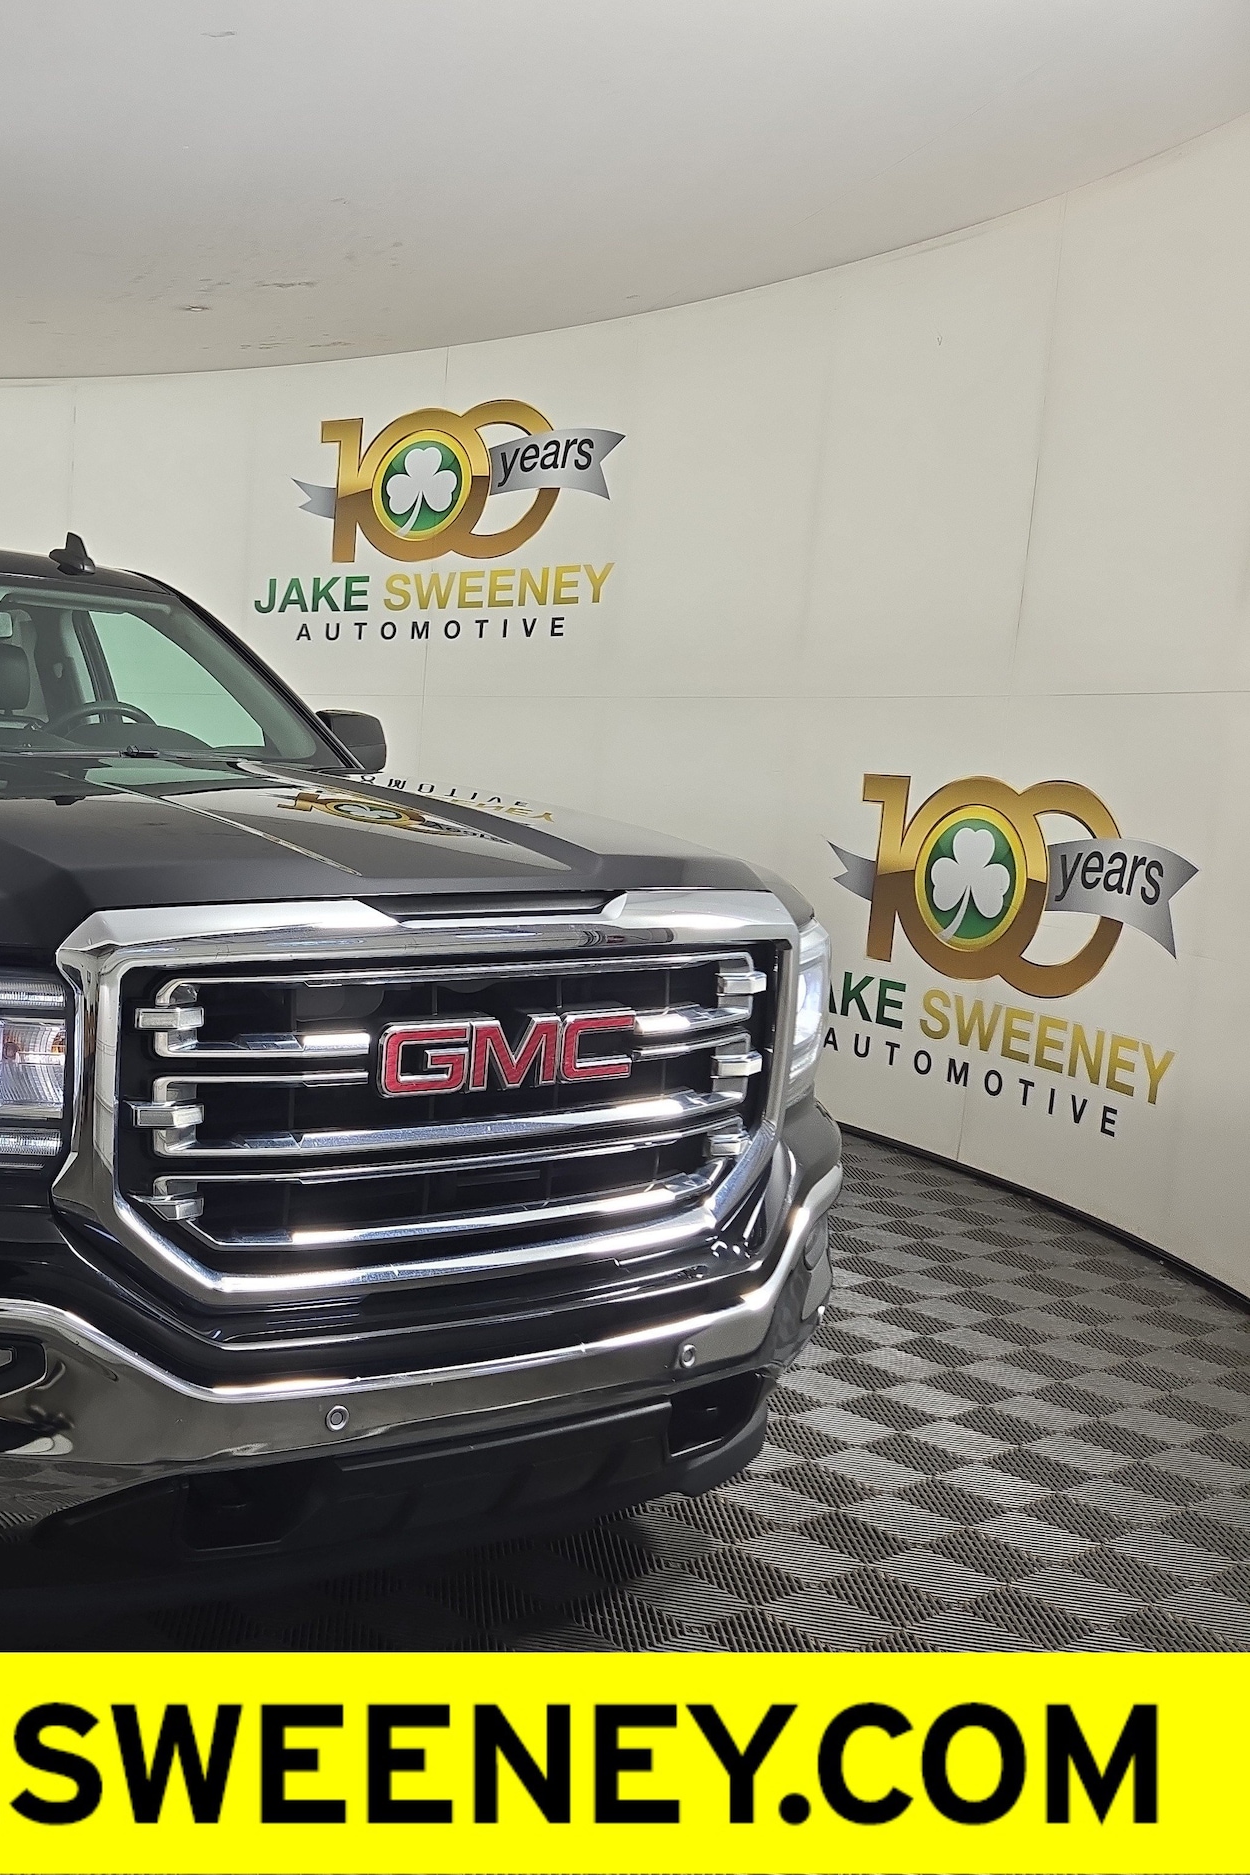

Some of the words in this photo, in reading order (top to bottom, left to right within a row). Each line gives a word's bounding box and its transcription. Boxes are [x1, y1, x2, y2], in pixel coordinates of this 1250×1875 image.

[498, 436, 594, 487] years
[254, 575, 370, 613] JAKE
[383, 562, 614, 611] SWEENEY
[296, 616, 565, 641] AUTOMOTIVE
[1055, 848, 1163, 905] years
[377, 1007, 636, 1098] GMC
[828, 971, 907, 1030] KE
[919, 989, 1175, 1104] SWEENEY
[823, 1027, 1119, 1137] AUTOMOTIVE
